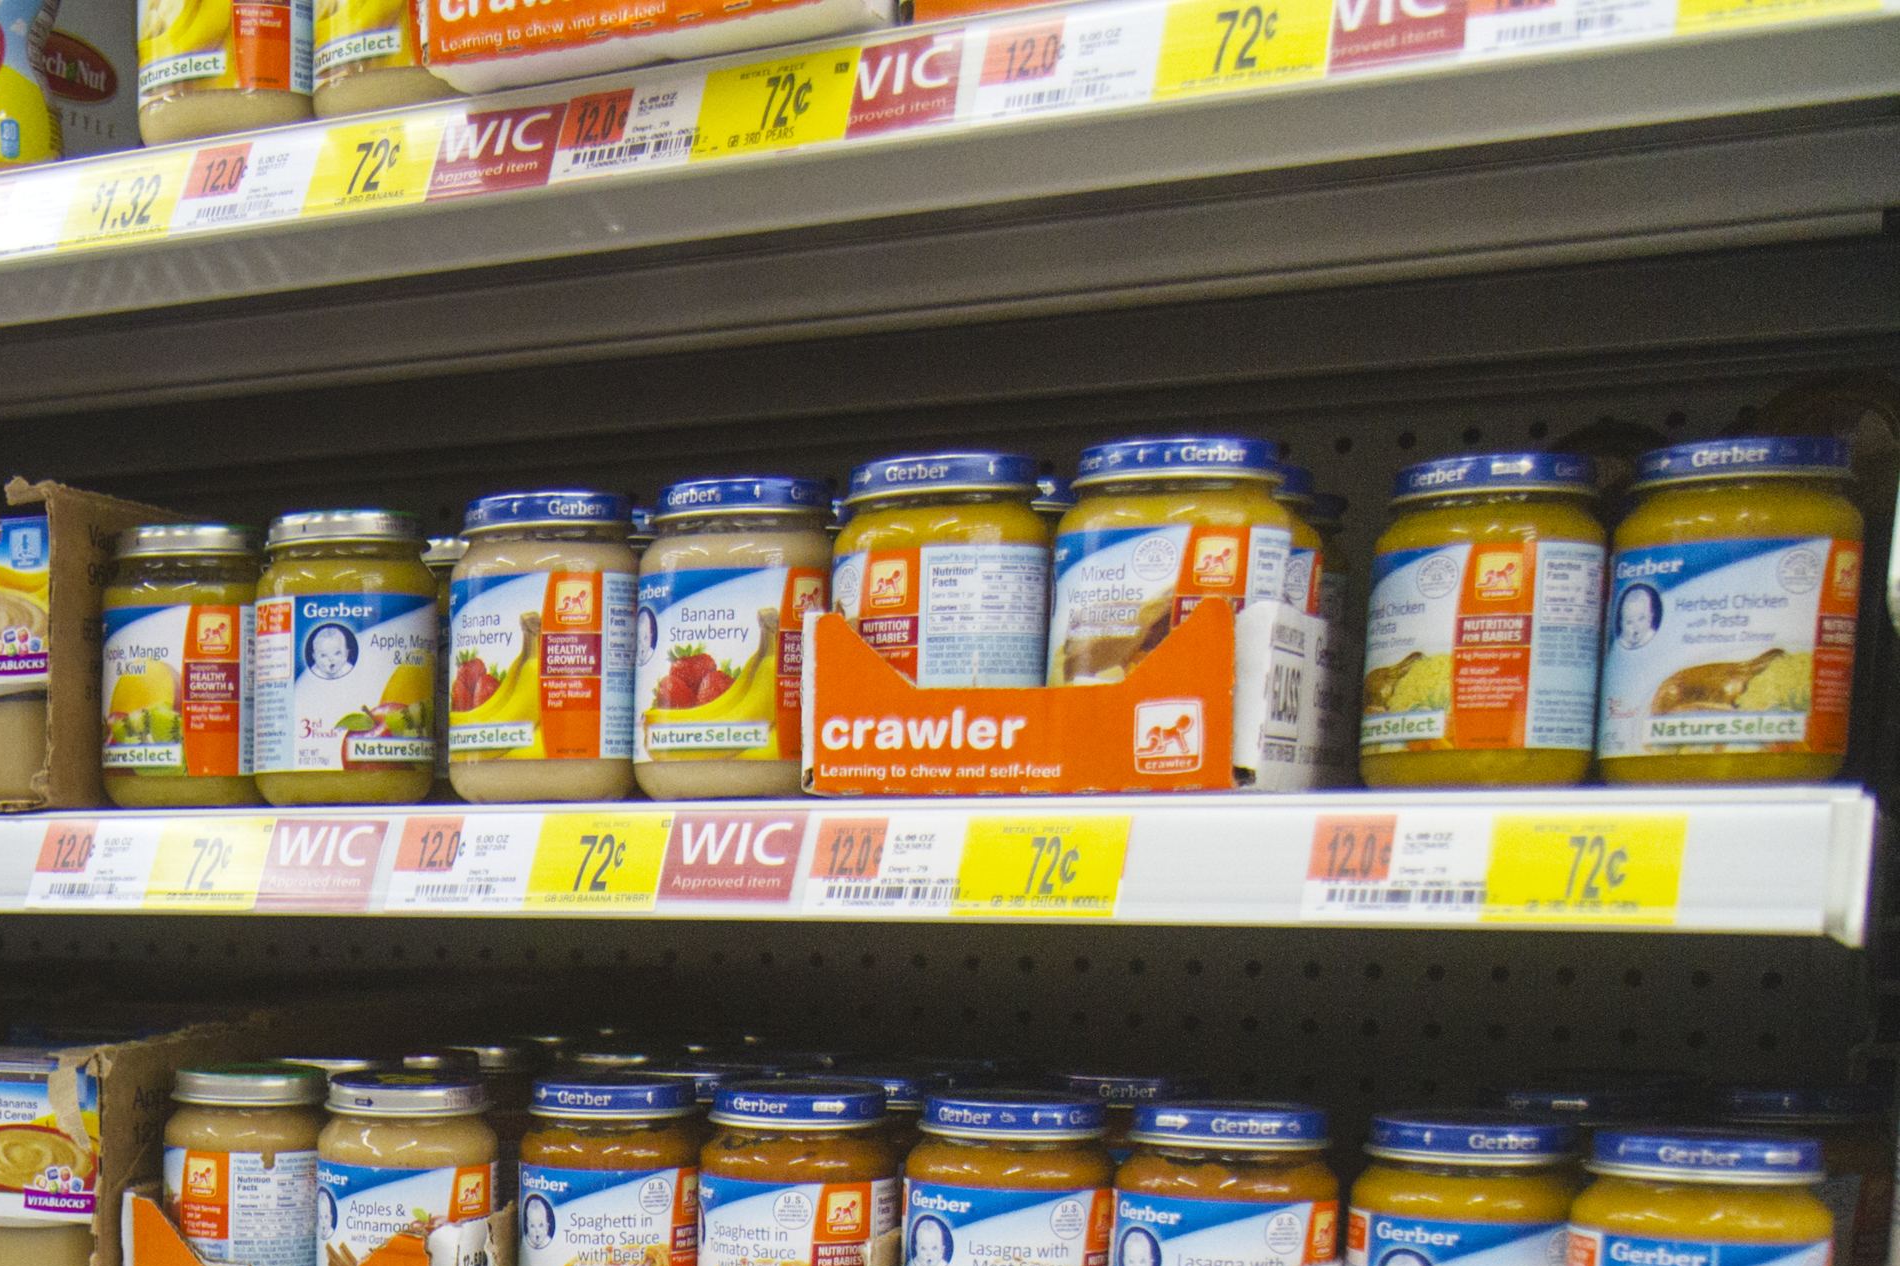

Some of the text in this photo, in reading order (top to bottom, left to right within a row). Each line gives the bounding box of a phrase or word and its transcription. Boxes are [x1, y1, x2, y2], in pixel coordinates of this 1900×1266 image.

[1209, 5, 1279, 75] 72¢
[909, 96, 946, 110] item
[728, 126, 795, 148] GB 3RD PEARS
[346, 134, 402, 197] 72¢
[435, 160, 539, 186] Approved item
[92, 173, 162, 231] $1.32
[1181, 447, 1246, 462] Gerber
[885, 463, 949, 481] Gerber
[1080, 566, 1125, 582] Mixed
[1067, 586, 1143, 604] Vegetables
[1675, 594, 1789, 612] Herbed Chicken
[303, 603, 372, 619] Gerber
[680, 607, 735, 623] Banana
[1383, 601, 1425, 616] Chicken
[462, 613, 500, 628] Banana
[1463, 618, 1523, 631] NUTRITION
[1711, 613, 1749, 628] Pasta
[370, 634, 412, 651] Apple,
[456, 628, 512, 647] Strawberry
[669, 624, 749, 643] Strawberry
[547, 643, 587, 655] HEALTHY
[190, 672, 228, 682] HEALTHY
[822, 709, 1027, 750] crawler
[820, 763, 1060, 779] Learning to chew and self-feed
[1145, 758, 1192, 770] crawler
[278, 826, 373, 867] WIC
[1030, 836, 1080, 895] 72¢
[1566, 835, 1629, 898] 72¢
[268, 873, 360, 891] Approved item
[1469, 1134, 1539, 1152] Gerber
[27, 1195, 91, 1210] VITABLOCKS
[345, 1217, 410, 1233] Cinnamon
[569, 1213, 653, 1233] Spaghetti in
[563, 1230, 660, 1246] Tomato Sauce
[710, 1240, 796, 1261] Tomato Sauce
[968, 1241, 1070, 1259] Lasagna with
